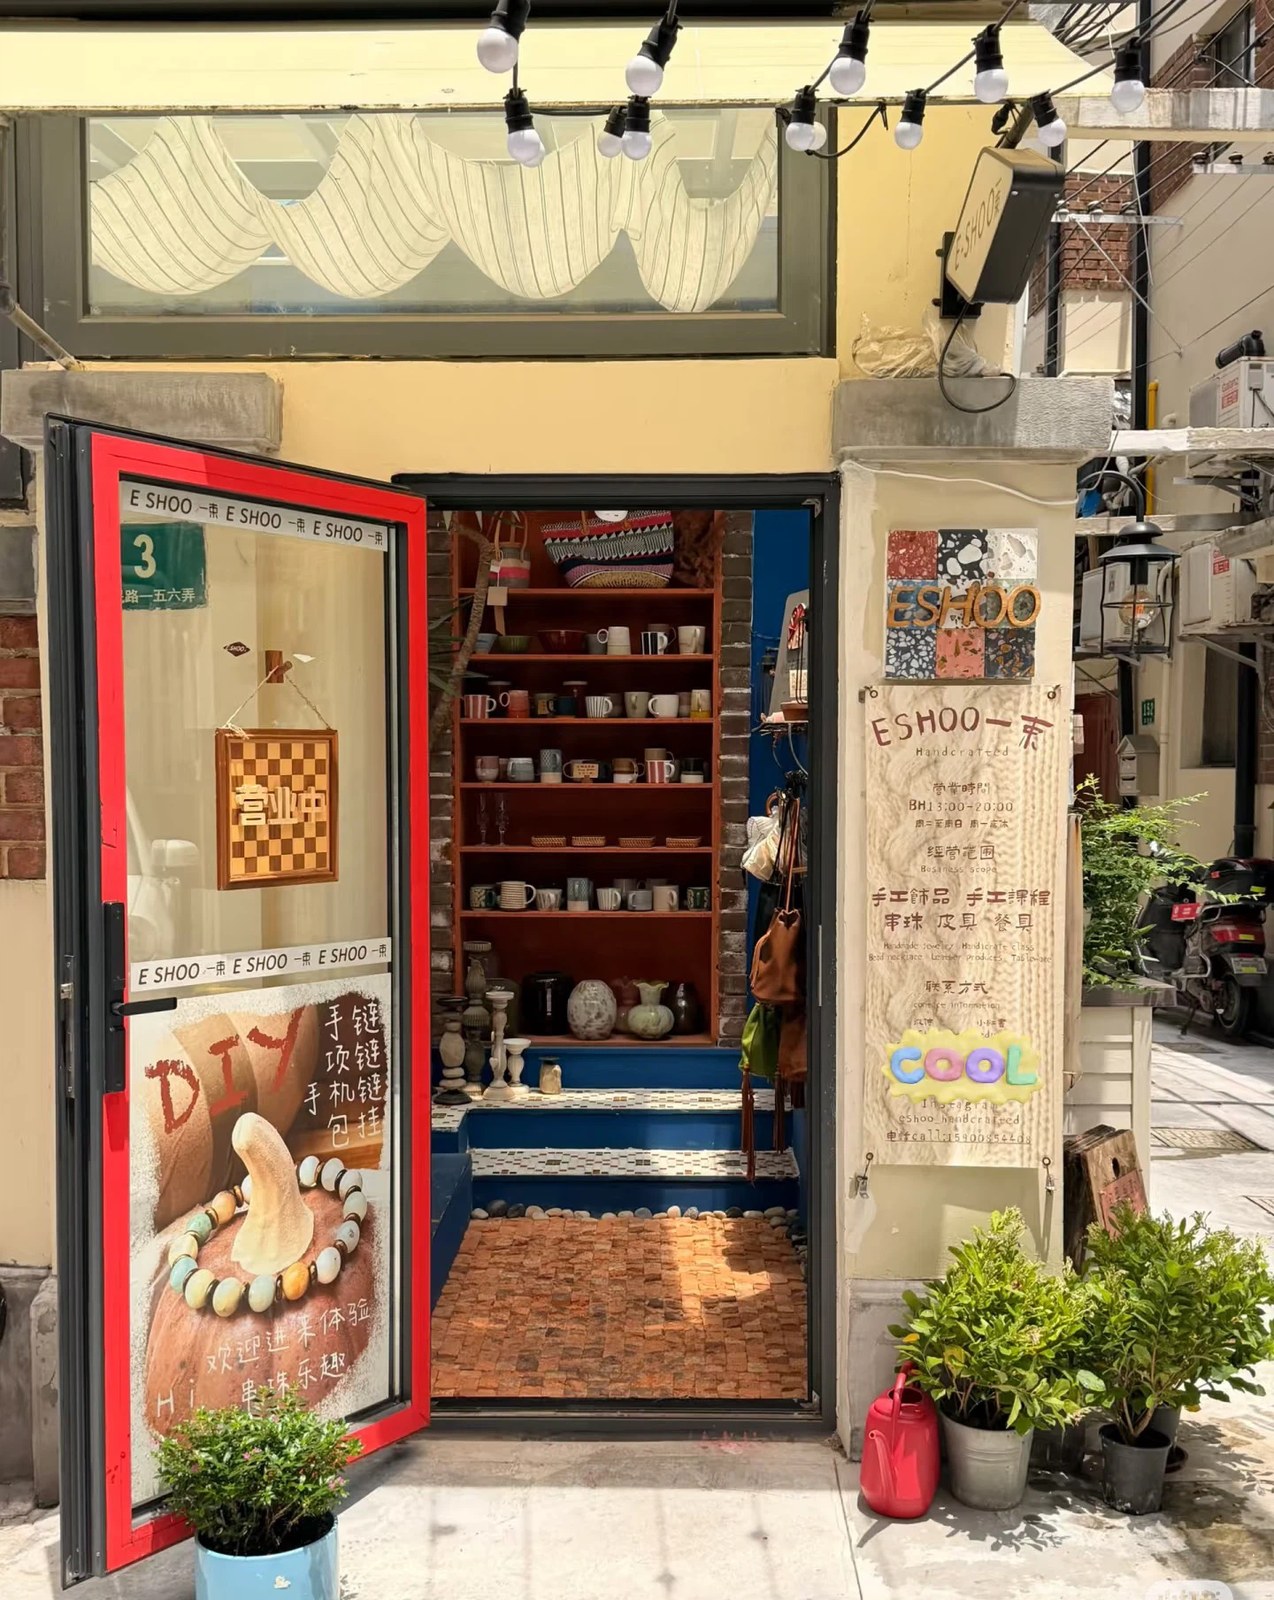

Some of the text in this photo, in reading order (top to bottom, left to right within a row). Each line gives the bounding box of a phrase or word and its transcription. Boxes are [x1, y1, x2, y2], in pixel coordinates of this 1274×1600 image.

[133, 534, 156, 579] 3
[122, 588, 196, 604] 路一五六弄
[886, 585, 1042, 628] ESHOO
[916, 746, 1009, 757] Handcrafted
[235, 784, 326, 826] 营业中
[938, 913, 978, 931] 皮具
[325, 1001, 381, 1042] 手链
[145, 1006, 305, 1134] DIY
[325, 1038, 381, 1074] 项链
[890, 1045, 1038, 1086] COOL
[304, 1073, 382, 1116] 手机链
[327, 1106, 383, 1149] 包挂
[207, 1298, 372, 1375] 欢迎进来体验
[241, 1352, 346, 1419] 串珠乐趣
